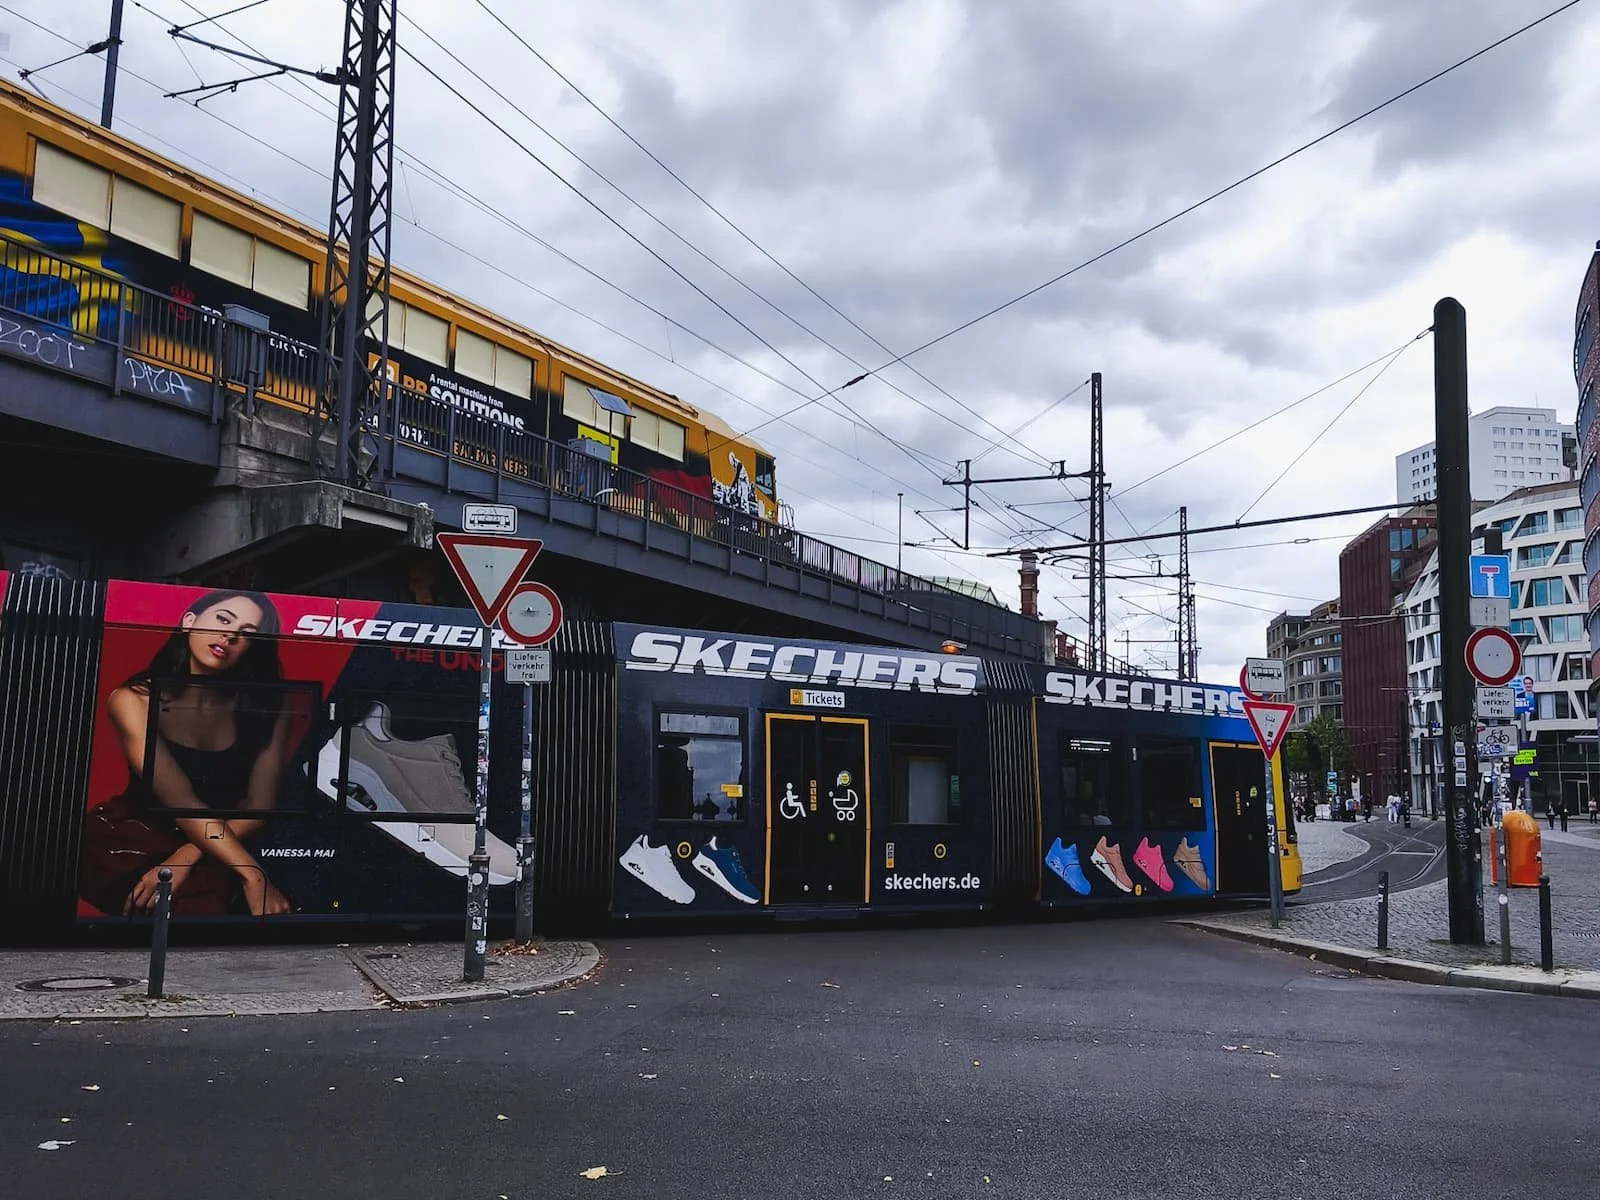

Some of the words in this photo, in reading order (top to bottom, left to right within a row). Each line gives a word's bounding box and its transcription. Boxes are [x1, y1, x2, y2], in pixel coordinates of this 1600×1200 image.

[429, 373, 436, 383] A
[436, 377, 458, 391] rental
[458, 385, 488, 402] machine
[488, 395, 504, 409] from
[390, 647, 434, 663] THE
[514, 652, 543, 661] Liefer-
[512, 662, 545, 670] verkehr
[625, 631, 979, 696] SKECHERS
[521, 671, 536, 679] frei
[805, 692, 842, 706] Tickets
[1043, 671, 1248, 718] SKECHERS
[1490, 707, 1503, 715] frei
[261, 848, 302, 857] VANESSA
[314, 849, 336, 858] MAI
[885, 872, 981, 890] skechers.de
